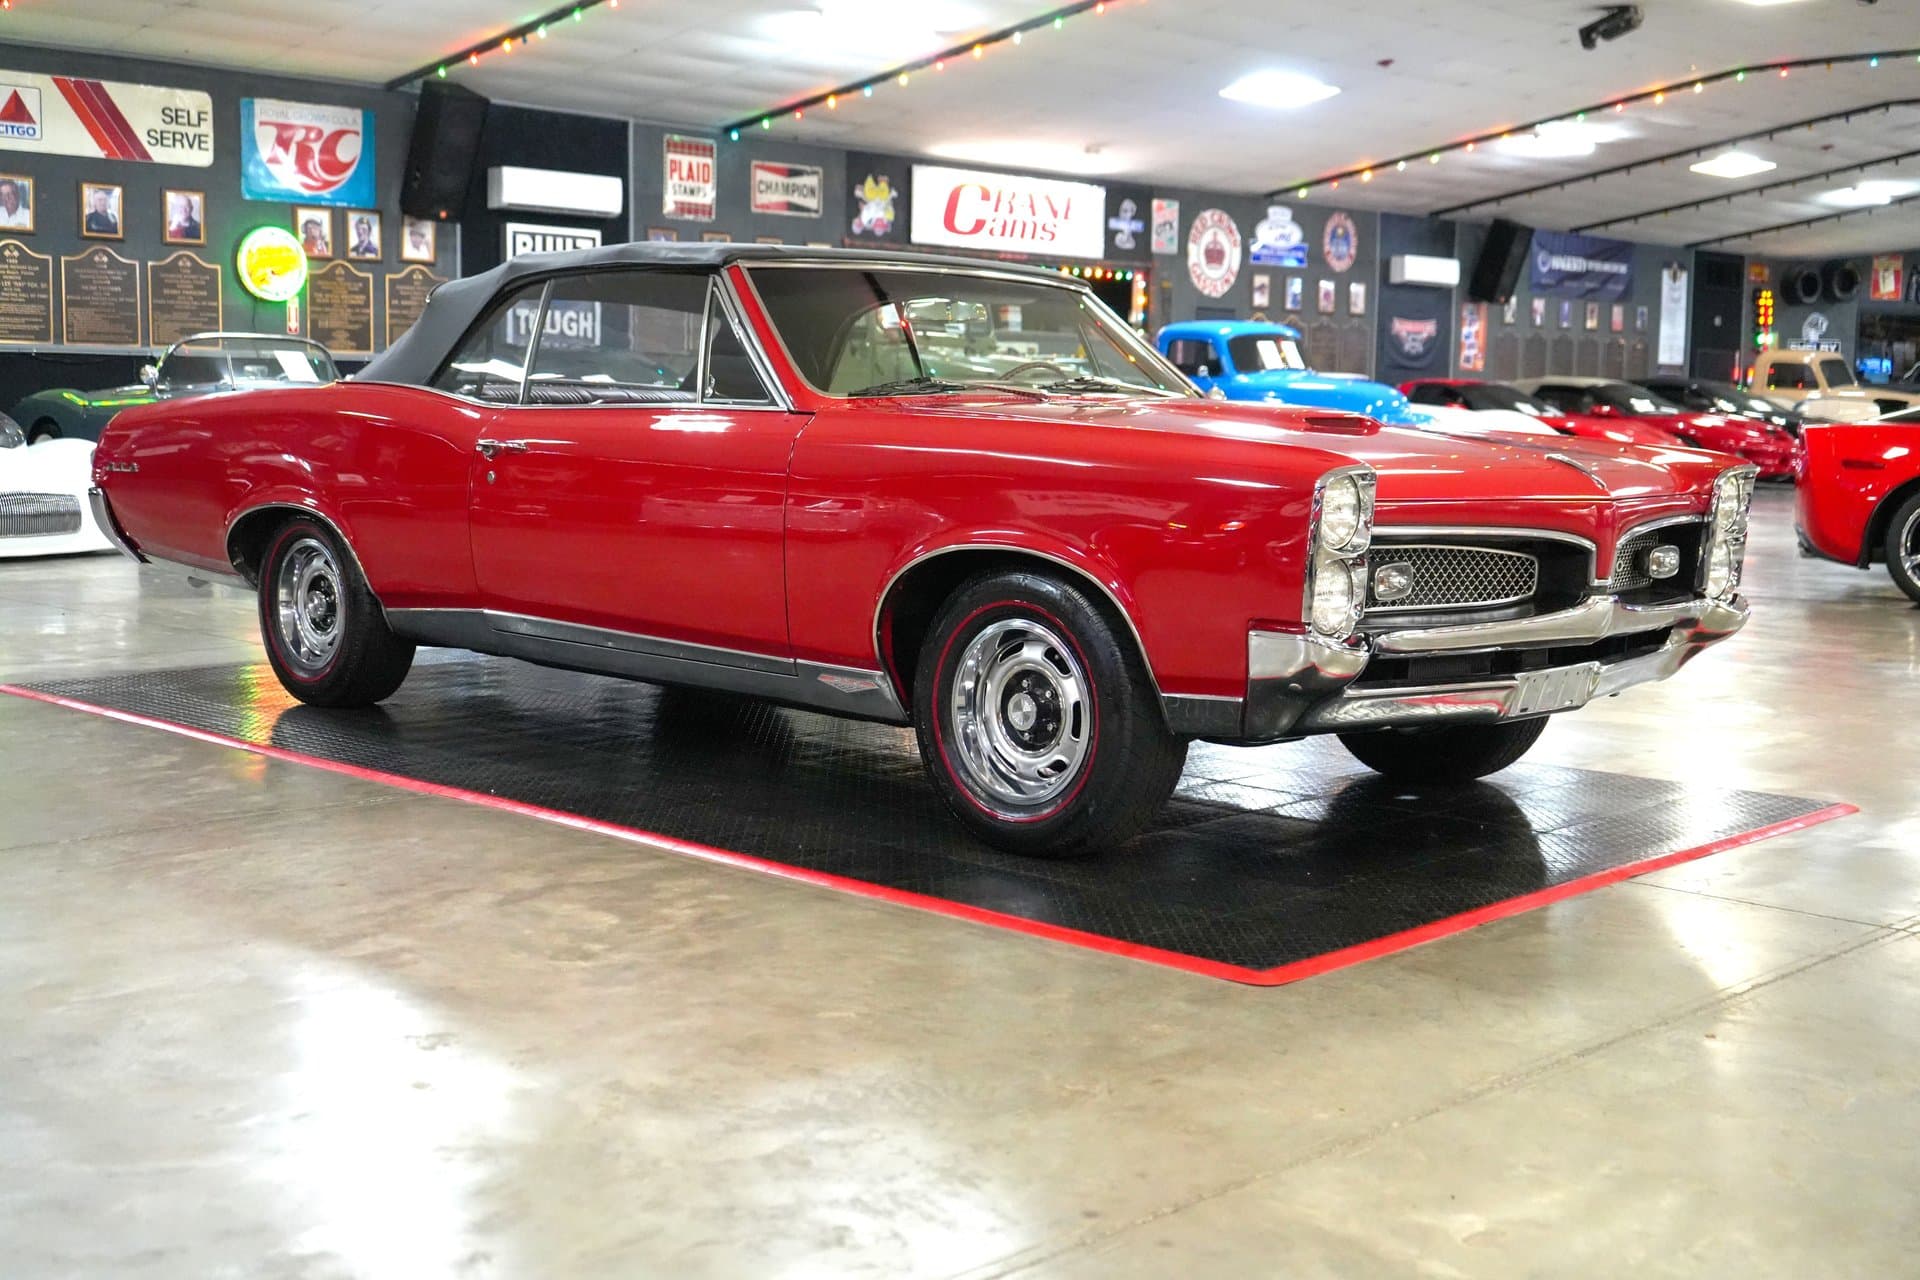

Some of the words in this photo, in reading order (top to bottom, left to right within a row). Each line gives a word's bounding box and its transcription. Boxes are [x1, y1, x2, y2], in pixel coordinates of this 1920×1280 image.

[162, 107, 209, 129] SELF
[147, 128, 210, 151] SERVE
[259, 120, 360, 192] RC
[670, 159, 711, 184] PLAID
[672, 184, 707, 198] STAMPS
[757, 180, 816, 199] CHAMPION
